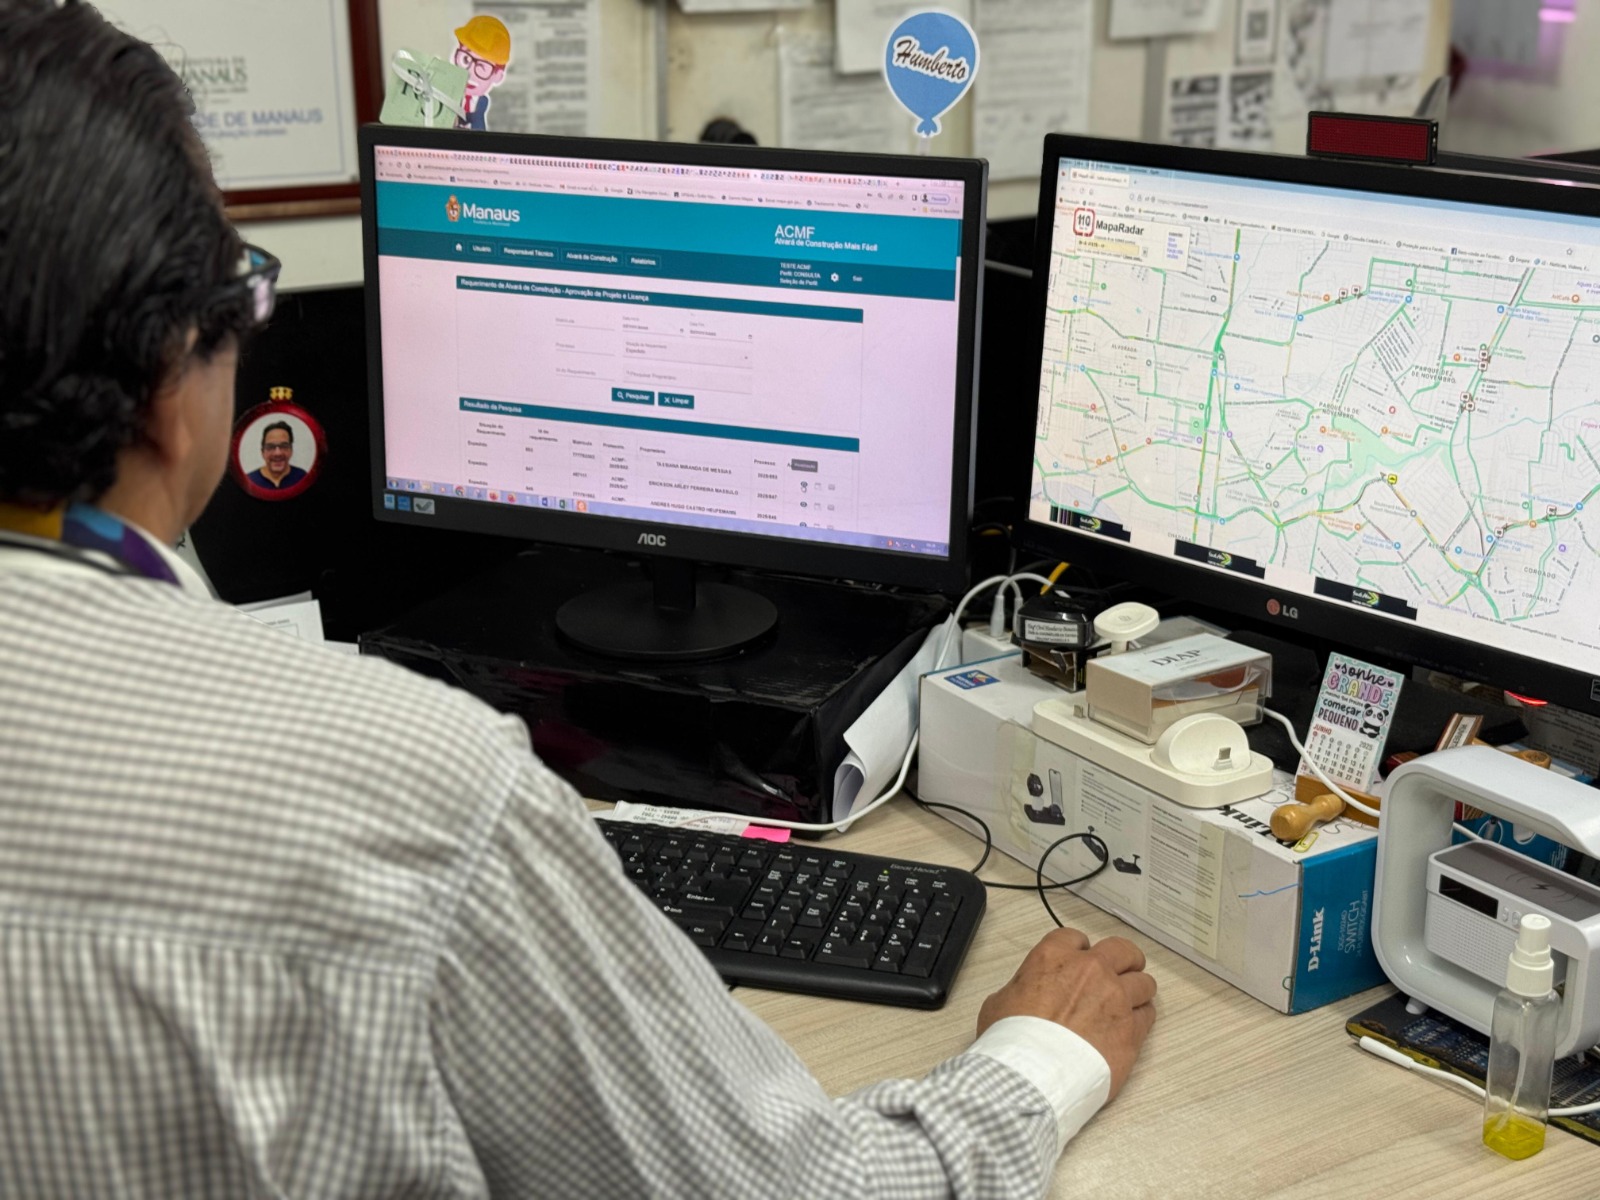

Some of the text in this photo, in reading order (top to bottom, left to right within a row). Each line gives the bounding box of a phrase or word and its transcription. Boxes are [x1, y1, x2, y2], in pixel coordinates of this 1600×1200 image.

[896, 39, 967, 81] Humberto
[462, 202, 521, 223] Manaus
[1077, 213, 1091, 228] 110
[775, 224, 816, 239] ACMF
[1095, 220, 1144, 237] MapaRadar
[774, 238, 795, 246] Alvará
[805, 240, 843, 251] Construção
[460, 278, 497, 289] Requerimento
[530, 284, 561, 294] Construção
[565, 287, 593, 298] Aprovação
[625, 392, 650, 402] Pesquisar
[463, 400, 492, 410] Resultado
[498, 403, 522, 414] Pesquisa
[637, 532, 667, 547] AOC
[1282, 604, 1298, 619] LG
[1151, 649, 1201, 666] DIAP
[1341, 662, 1387, 687] sonhe
[1327, 671, 1393, 709] GRANDE
[1323, 698, 1362, 717] começar
[1318, 707, 1360, 731] PEQUENO
[1313, 724, 1332, 735] JUNHO
[1344, 900, 1360, 954] SWITCH
[1307, 906, 1325, 973] D-Link
